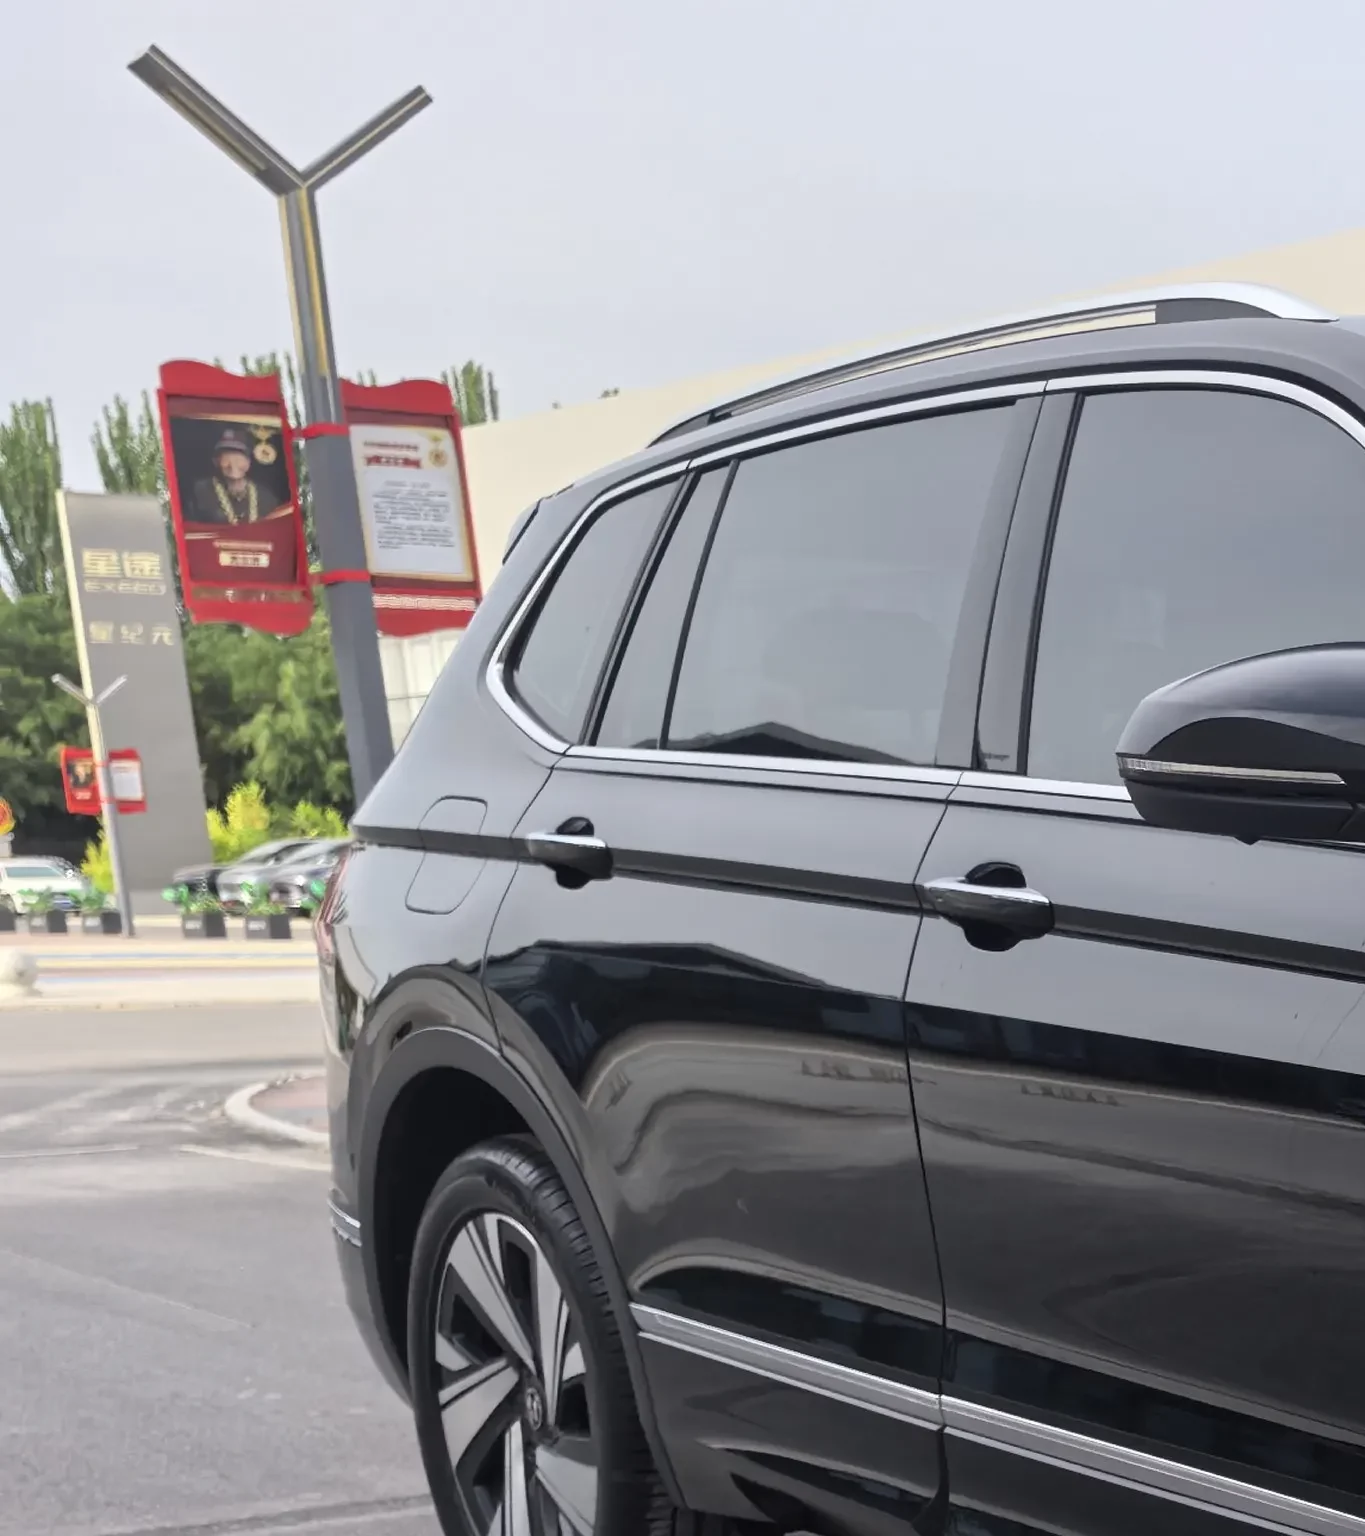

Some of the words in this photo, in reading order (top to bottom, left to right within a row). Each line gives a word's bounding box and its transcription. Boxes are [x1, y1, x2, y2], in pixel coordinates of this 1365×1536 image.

[82, 548, 164, 579] 星途
[88, 621, 175, 646] 星纪元
